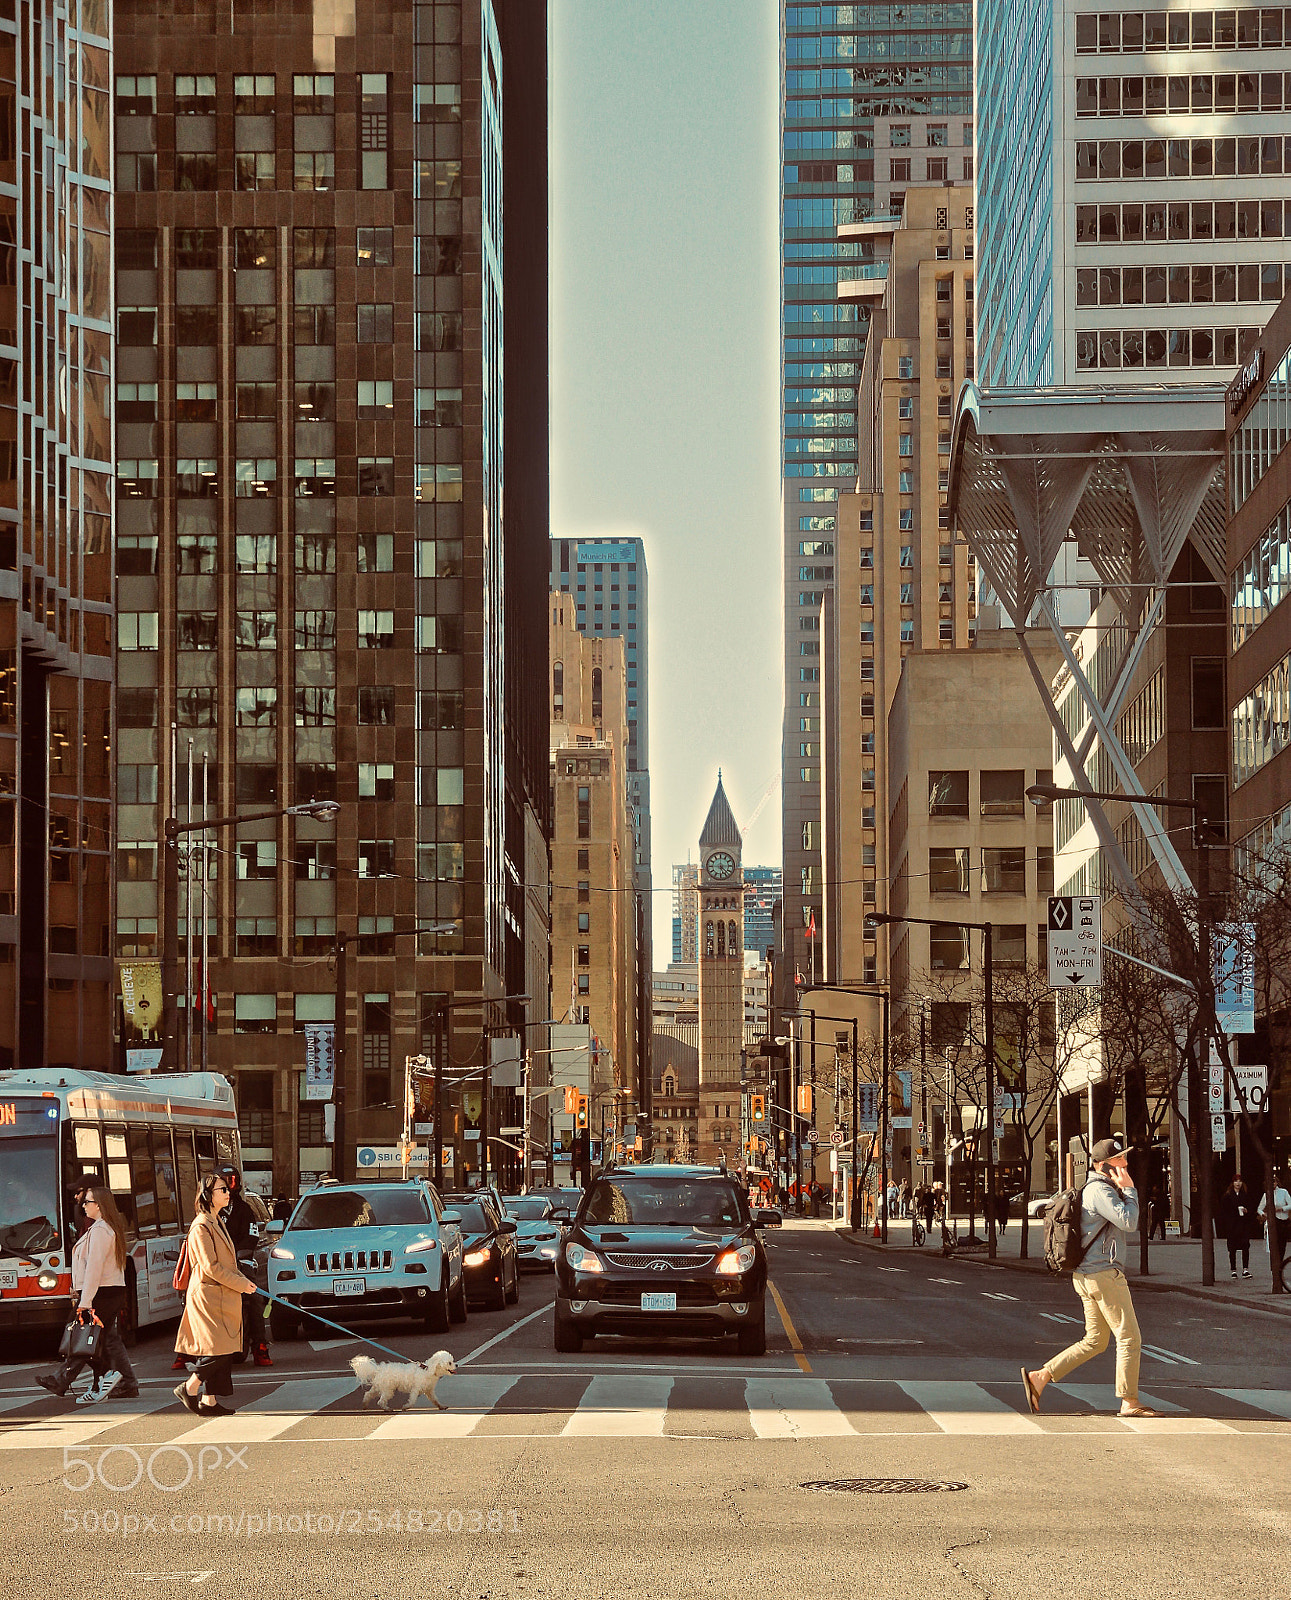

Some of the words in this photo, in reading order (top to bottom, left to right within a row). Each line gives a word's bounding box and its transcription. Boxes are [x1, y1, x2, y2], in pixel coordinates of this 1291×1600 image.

[580, 552, 606, 560] Munich
[1053, 946, 1069, 956] 7AM
[1081, 946, 1097, 956] 7PM
[1056, 959, 1094, 968] MON-FRI
[122, 968, 136, 1015] ACHIEVE
[306, 1026, 316, 1082] OPPORTUNITY
[1234, 1085, 1264, 1106] 40
[377, 1153, 393, 1162] SBI
[395, 1153, 428, 1162] Cada
